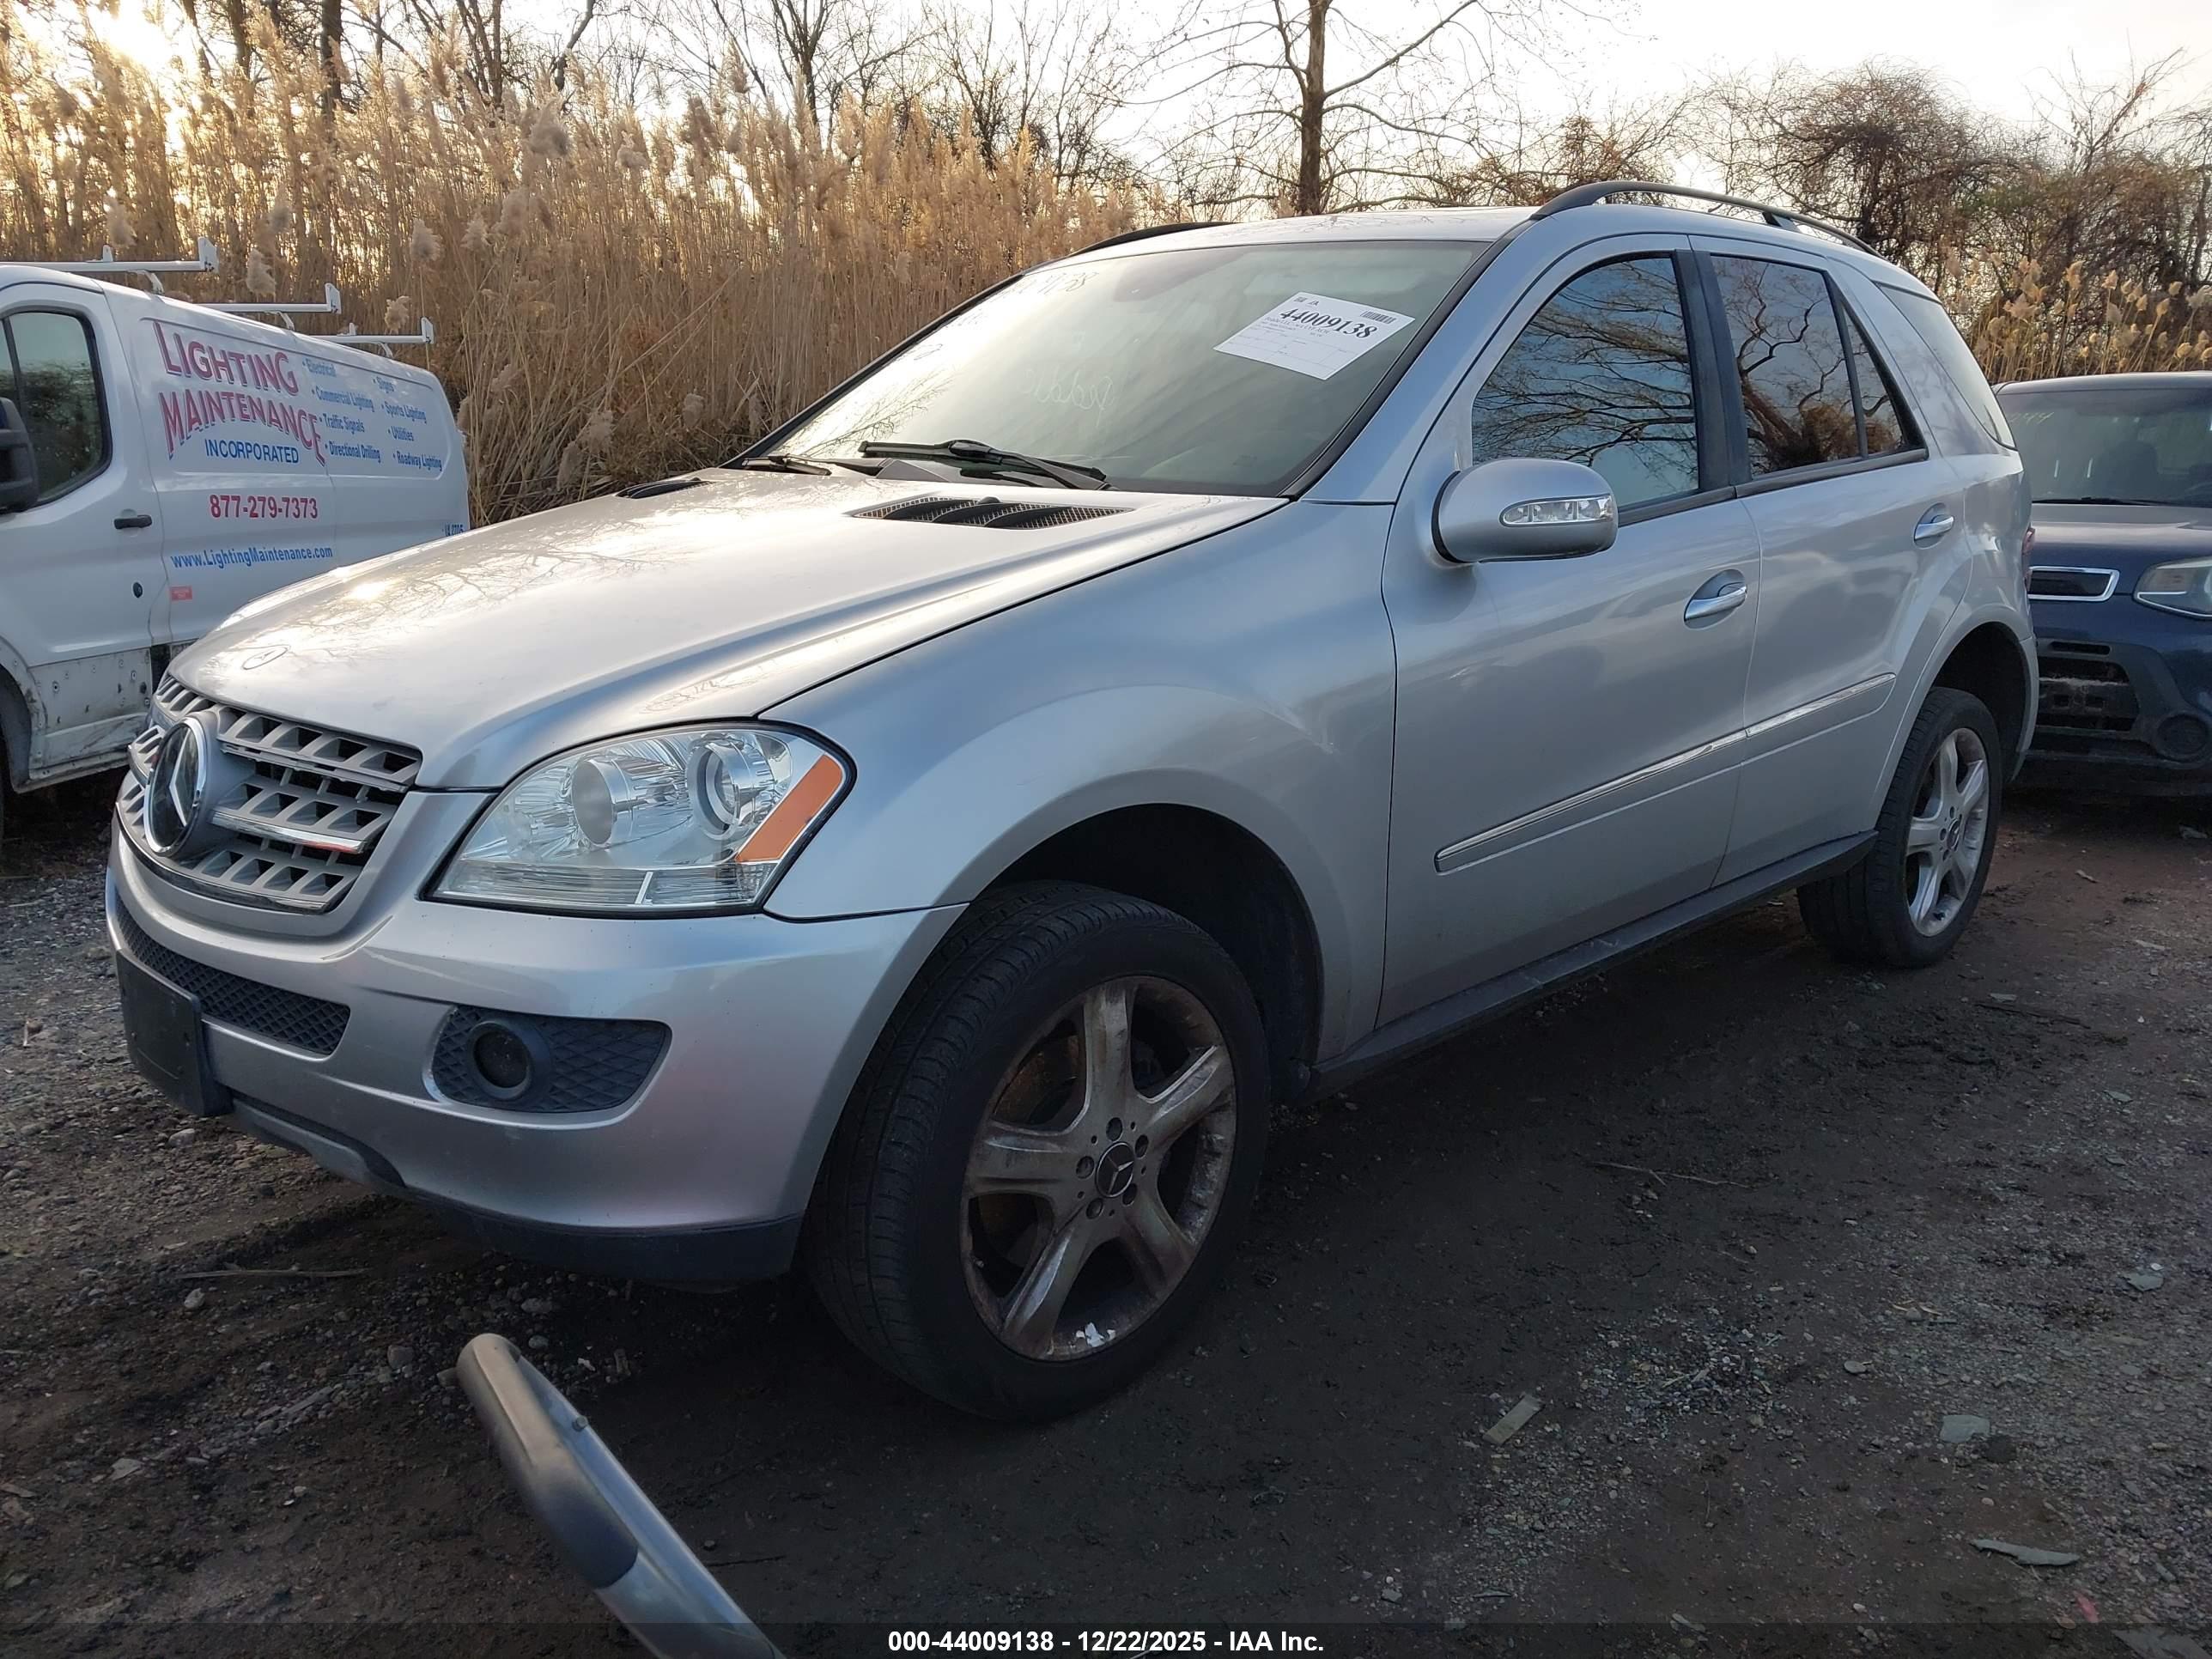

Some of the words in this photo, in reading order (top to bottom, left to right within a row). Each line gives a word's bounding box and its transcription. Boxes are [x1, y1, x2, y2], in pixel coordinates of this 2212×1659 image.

[1279, 308, 1378, 338] 44009138
[153, 321, 299, 396] LIGHTING
[376, 376, 394, 393] Signs
[316, 386, 351, 405] Commercial
[350, 392, 374, 412] Lighting
[323, 413, 343, 429] Traffic
[343, 416, 365, 434] Signals
[384, 401, 404, 418] Sports
[404, 404, 427, 424] Lighting
[158, 389, 325, 466] MAINTENANCE
[391, 426, 414, 441] Utilities
[204, 439, 299, 464] INCORPORATED
[329, 441, 362, 458] Directional
[361, 444, 381, 464] Drilling
[397, 451, 422, 470] Roadway
[421, 454, 442, 472] Lighting
[210, 495, 319, 519] 877-279-7373
[171, 546, 333, 569] www.LightingMaintenance.com
